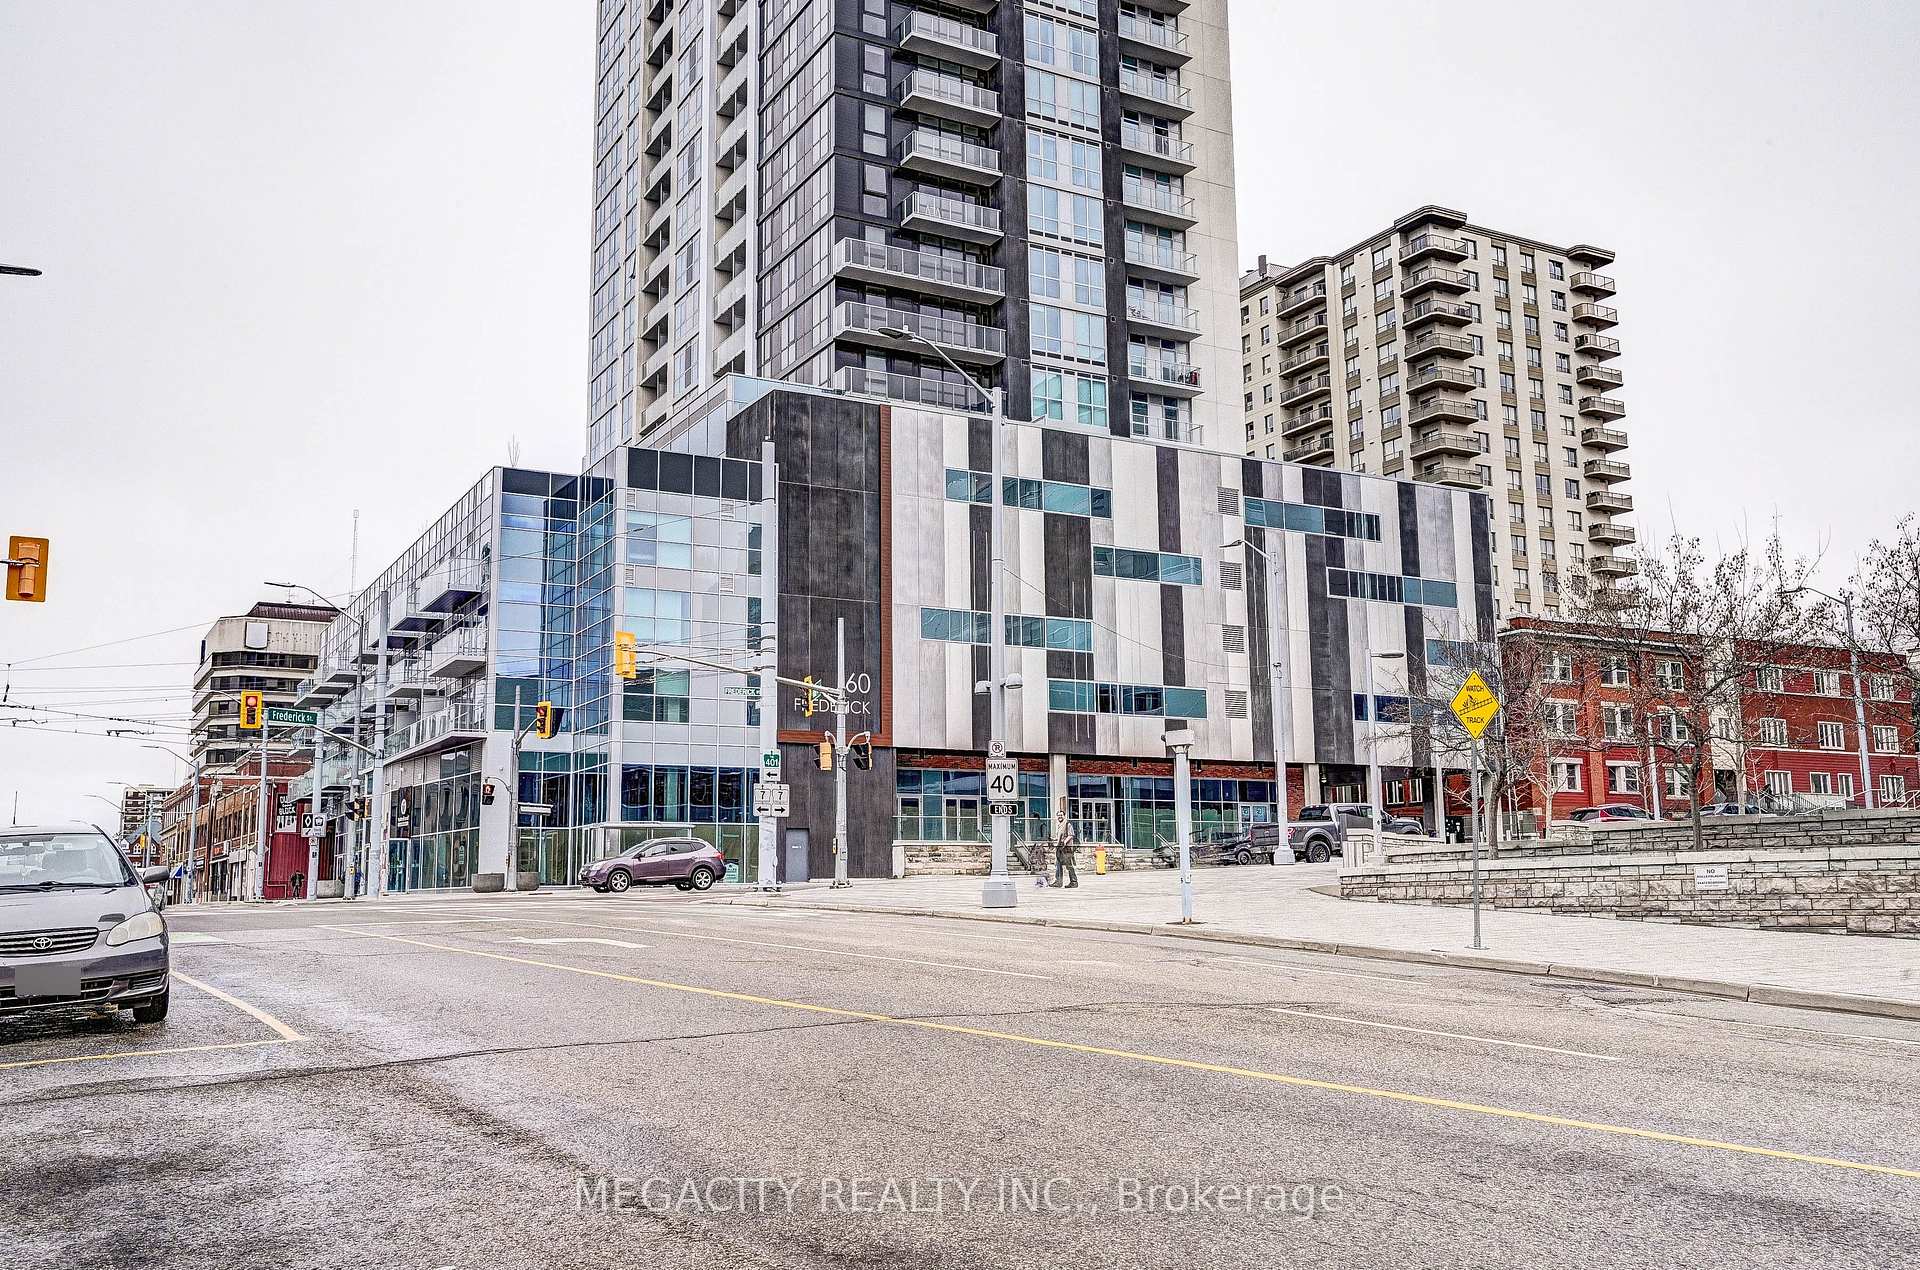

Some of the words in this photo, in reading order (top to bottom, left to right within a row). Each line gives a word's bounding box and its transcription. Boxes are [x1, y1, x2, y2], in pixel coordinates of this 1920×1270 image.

[846, 673, 871, 693] 60
[794, 697, 871, 715] FEDEICK
[272, 710, 306, 722] Frederick
[765, 758, 779, 767] 401
[988, 762, 1016, 770] MAXIMUM
[990, 774, 1014, 793] 40
[760, 790, 766, 800] 7
[778, 791, 784, 801] 7
[994, 805, 1013, 814] ENDS
